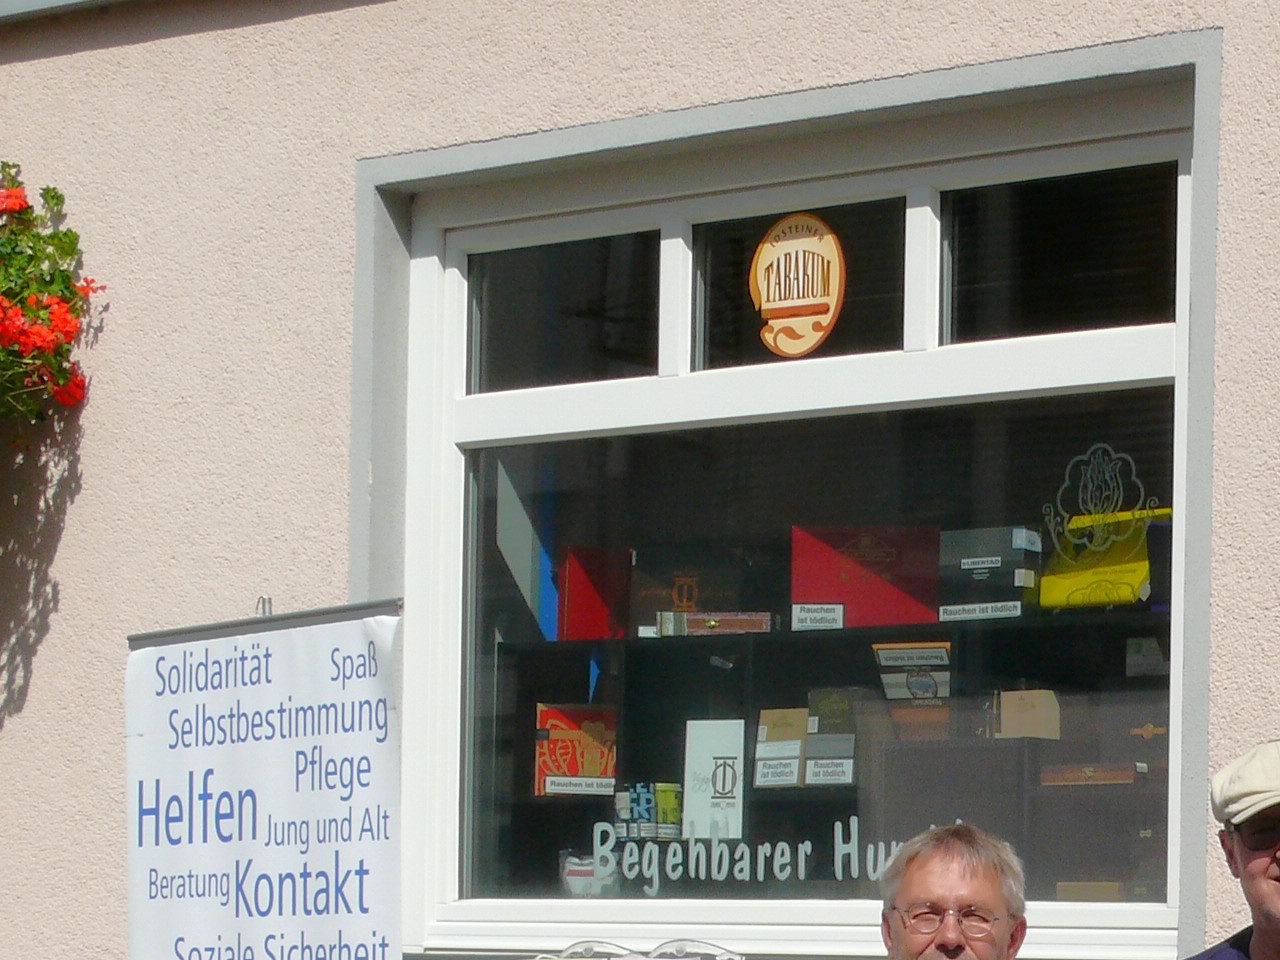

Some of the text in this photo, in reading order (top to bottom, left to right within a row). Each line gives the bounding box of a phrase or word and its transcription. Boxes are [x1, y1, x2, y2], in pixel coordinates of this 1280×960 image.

[770, 224, 825, 248] IDSTEINER
[764, 250, 831, 303] TABAKUM
[800, 606, 835, 614] Rauchen
[809, 616, 837, 625] tödlich
[942, 607, 976, 616] Rauchen
[990, 604, 1018, 613] tödlich
[155, 643, 272, 697] Solidarität
[330, 641, 377, 689] Spaß
[168, 696, 388, 750] Selbstbestimmung
[295, 745, 371, 801] Pflege
[771, 770, 793, 778] tödlich
[814, 761, 844, 769] Rauchen
[823, 770, 846, 778] tödlich
[137, 769, 257, 847] Helfen
[264, 805, 389, 854] Jung und Alt
[593, 820, 812, 897] Begehbarer
[148, 868, 230, 906] Beratung
[235, 851, 369, 918] Kontakt
